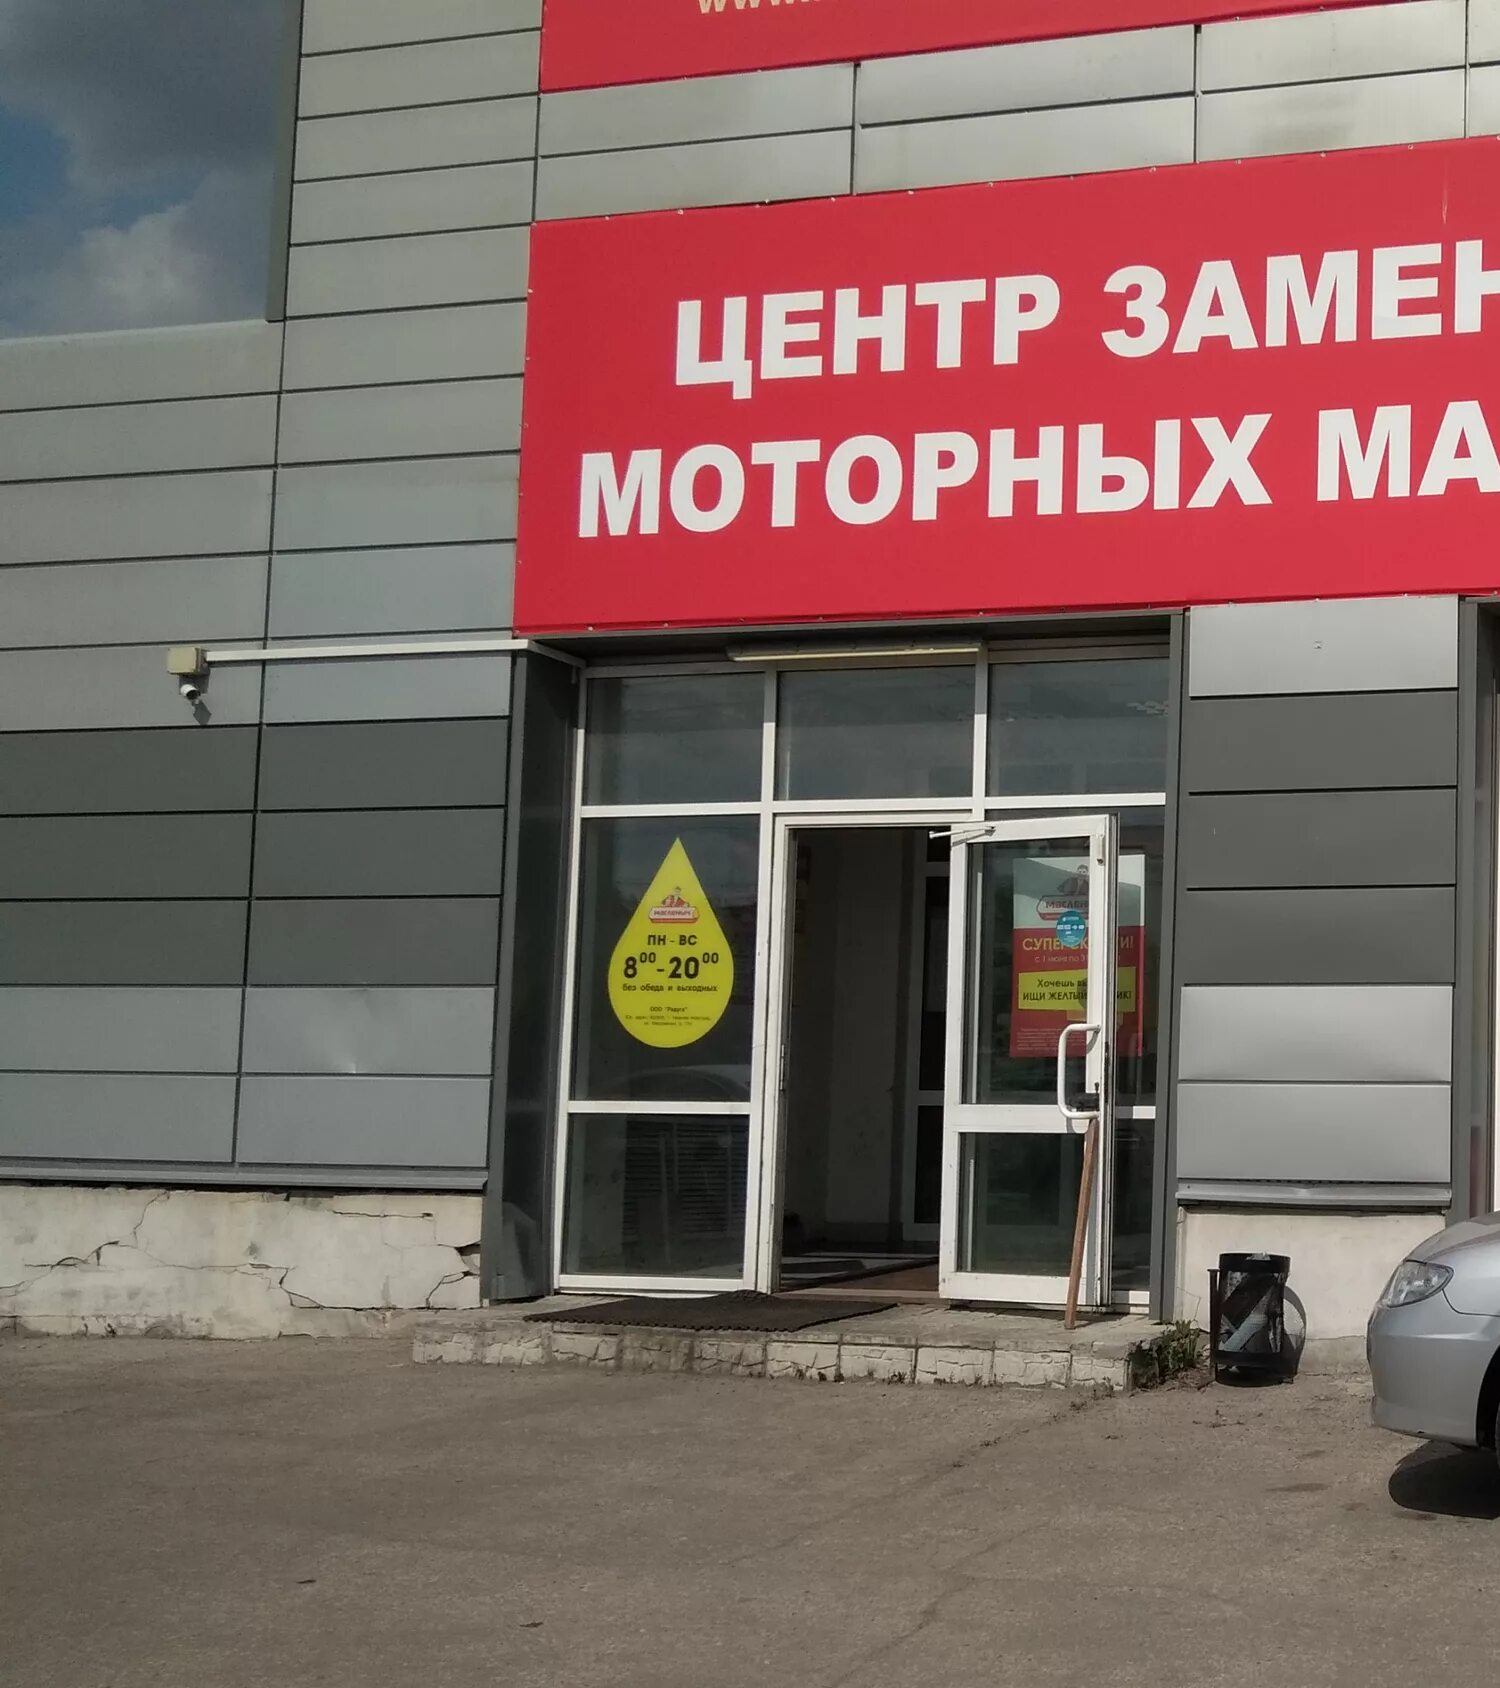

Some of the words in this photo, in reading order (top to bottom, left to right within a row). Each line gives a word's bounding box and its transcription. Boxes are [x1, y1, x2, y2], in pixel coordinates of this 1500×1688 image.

[676, 275, 1060, 400] ЦЕНТР
[578, 413, 1272, 538] МОТОРНЫХ
[647, 935, 666, 946] ПН
[679, 935, 698, 946] ВС
[622, 983, 637, 992] без
[640, 983, 664, 993] обеда
[677, 984, 718, 993] выходных
[1037, 979, 1075, 988] Хочешь
[1023, 991, 1046, 1001] ИЩИ
